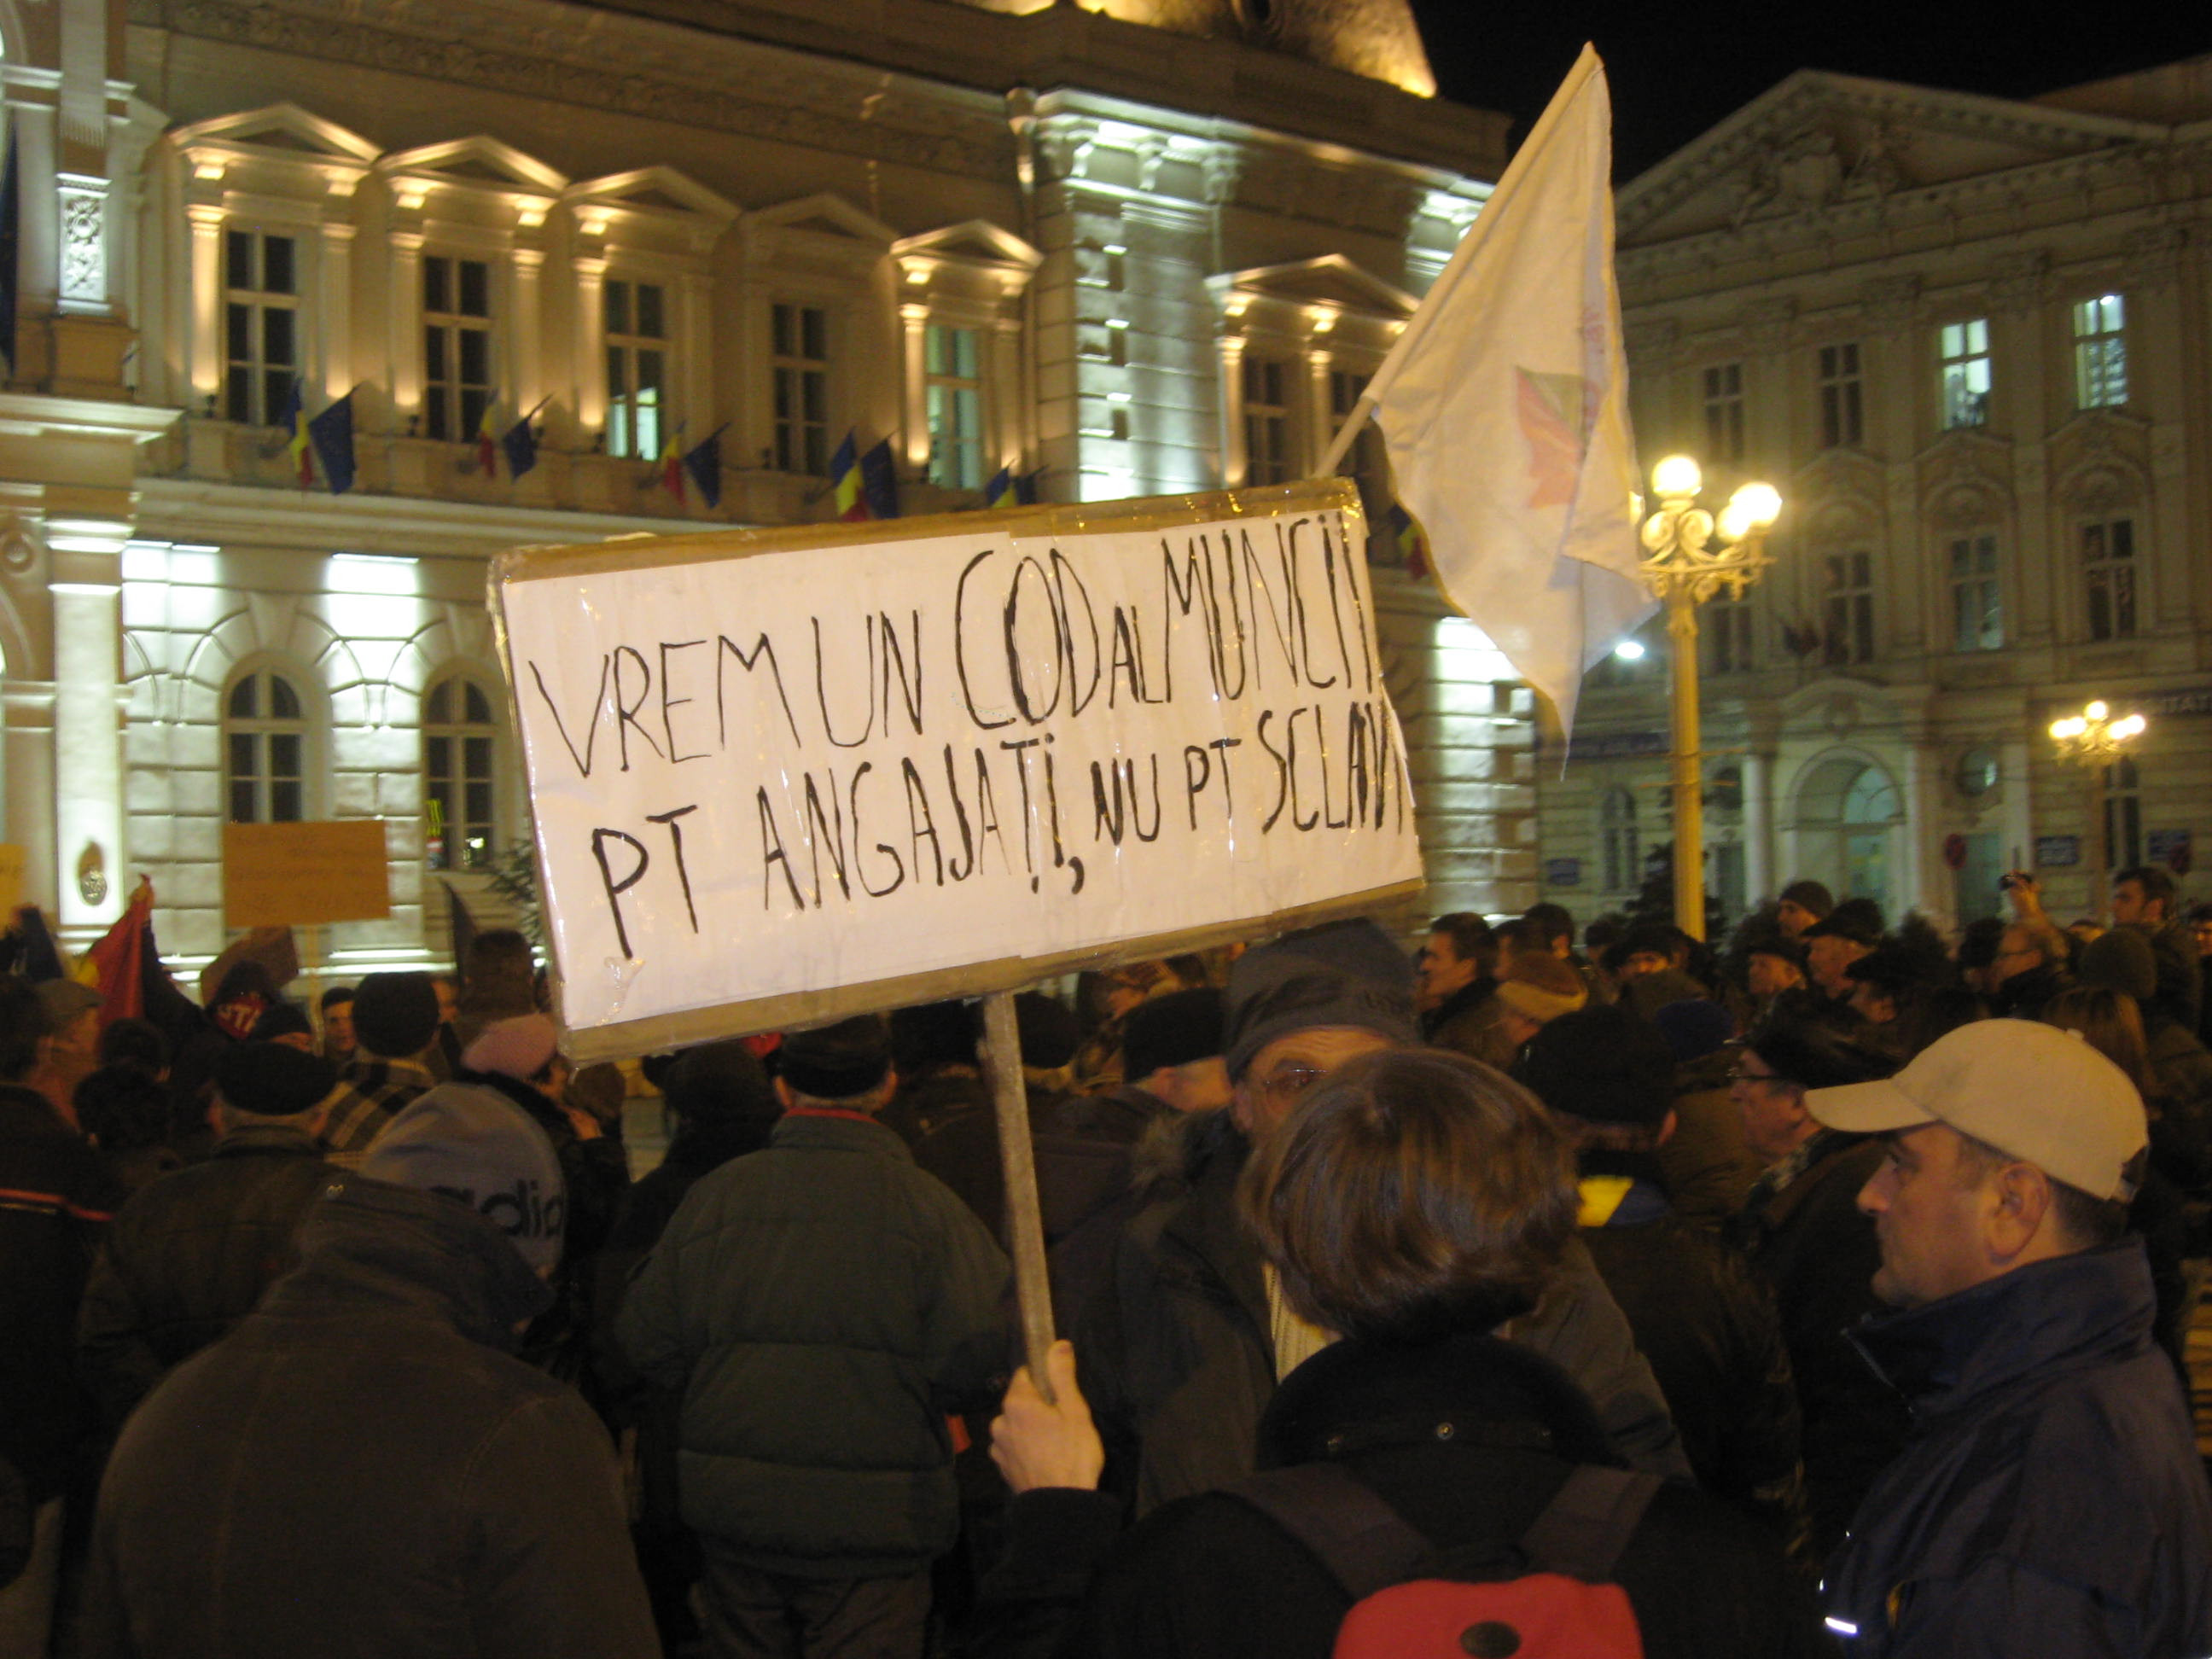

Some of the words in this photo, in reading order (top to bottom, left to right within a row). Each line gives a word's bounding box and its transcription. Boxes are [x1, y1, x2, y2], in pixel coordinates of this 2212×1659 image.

[528, 632, 800, 777] VREM
[811, 609, 923, 747] UN
[955, 548, 1100, 730] COD
[1109, 602, 1163, 709] AL
[1161, 510, 1372, 702] MUNCII
[591, 805, 698, 960] PT
[1090, 754, 1161, 846] NU
[1184, 737, 1243, 831] PT
